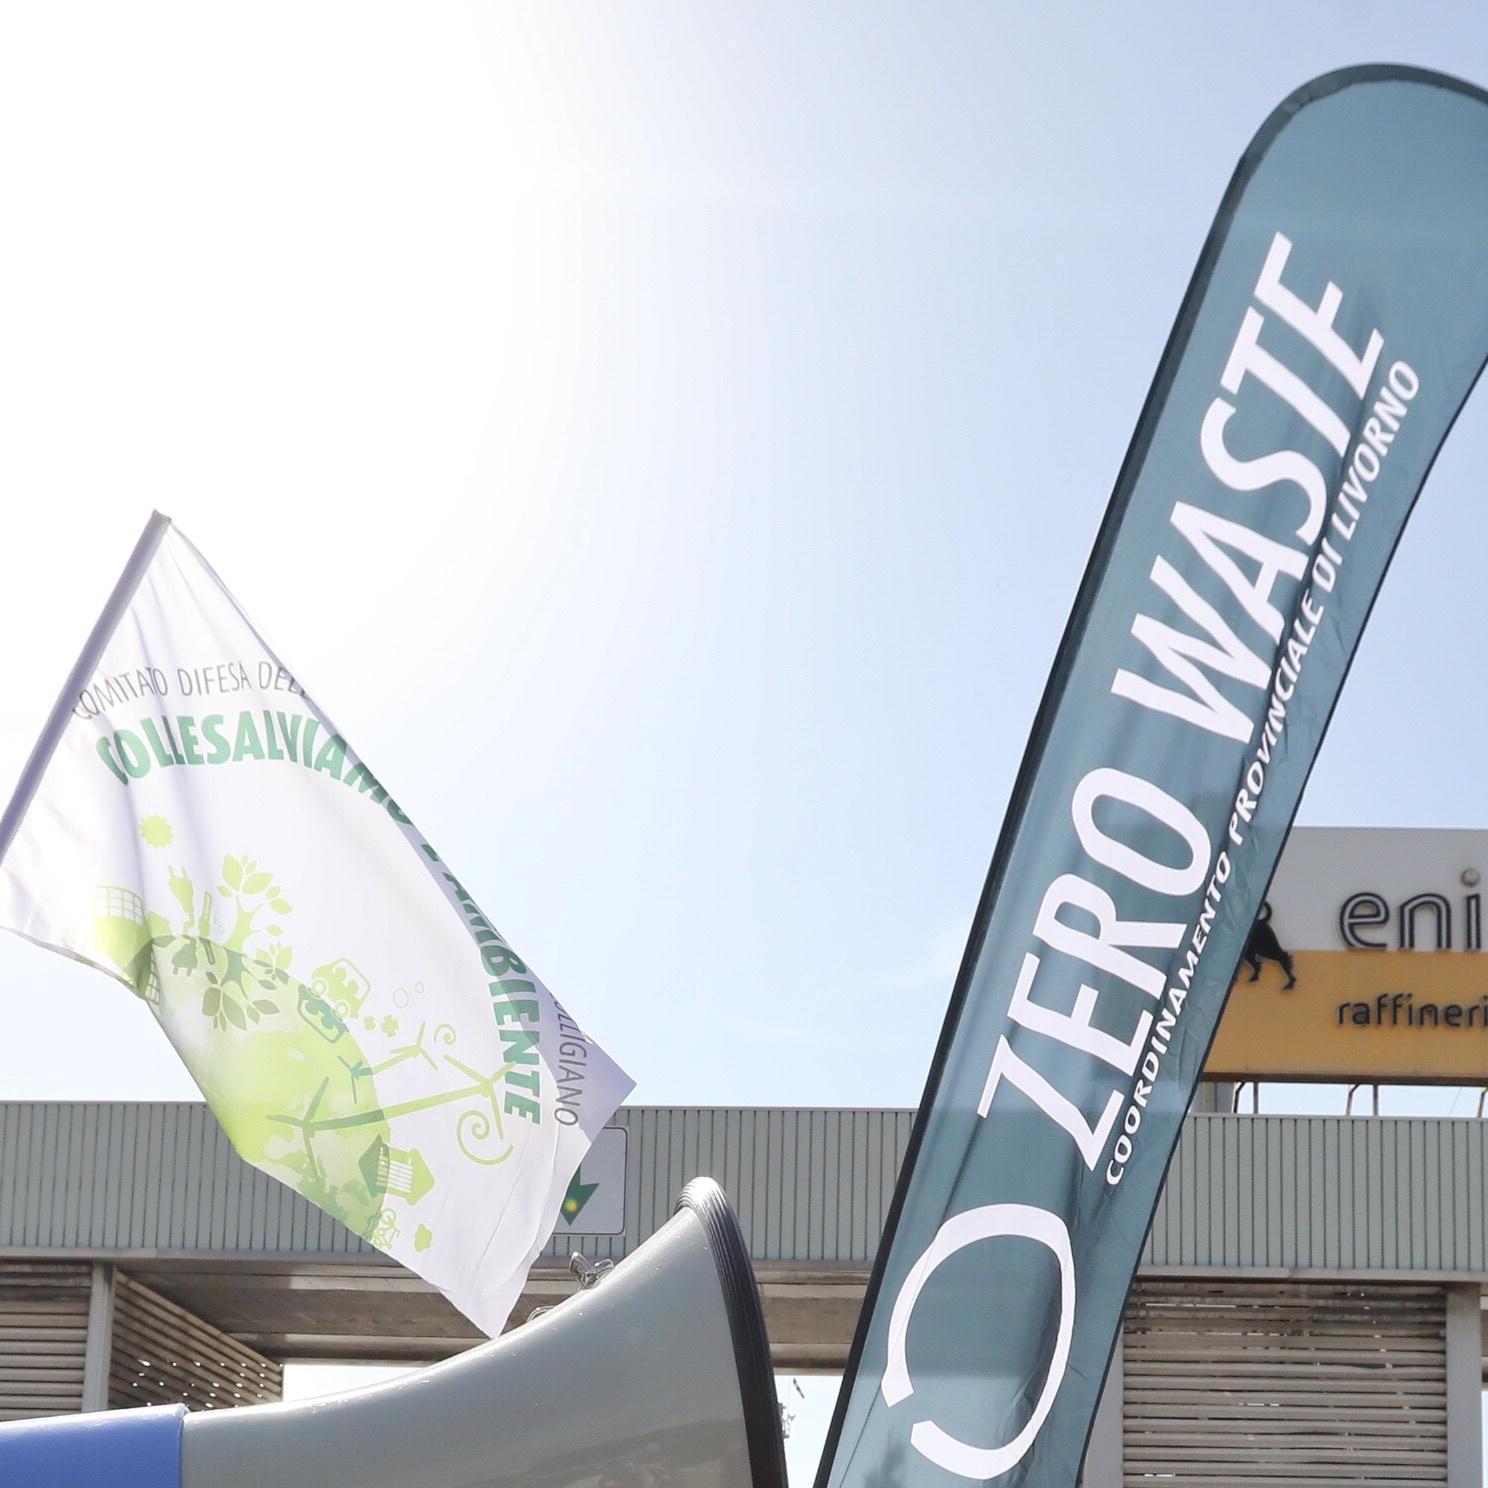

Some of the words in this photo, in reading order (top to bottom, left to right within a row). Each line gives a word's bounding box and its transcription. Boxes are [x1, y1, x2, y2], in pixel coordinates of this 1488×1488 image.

[72, 667, 168, 719] COMITATO
[177, 660, 252, 697] DIFESA
[977, 767, 1211, 1171] ZERO
[1111, 231, 1384, 744] WASTE
[1106, 851, 1231, 1185] COORDINAMENTO
[1228, 588, 1324, 846] PROVINCIALE
[1312, 537, 1342, 593] DI
[1331, 361, 1419, 540] LIVORNO
[1339, 867, 1482, 951] eni
